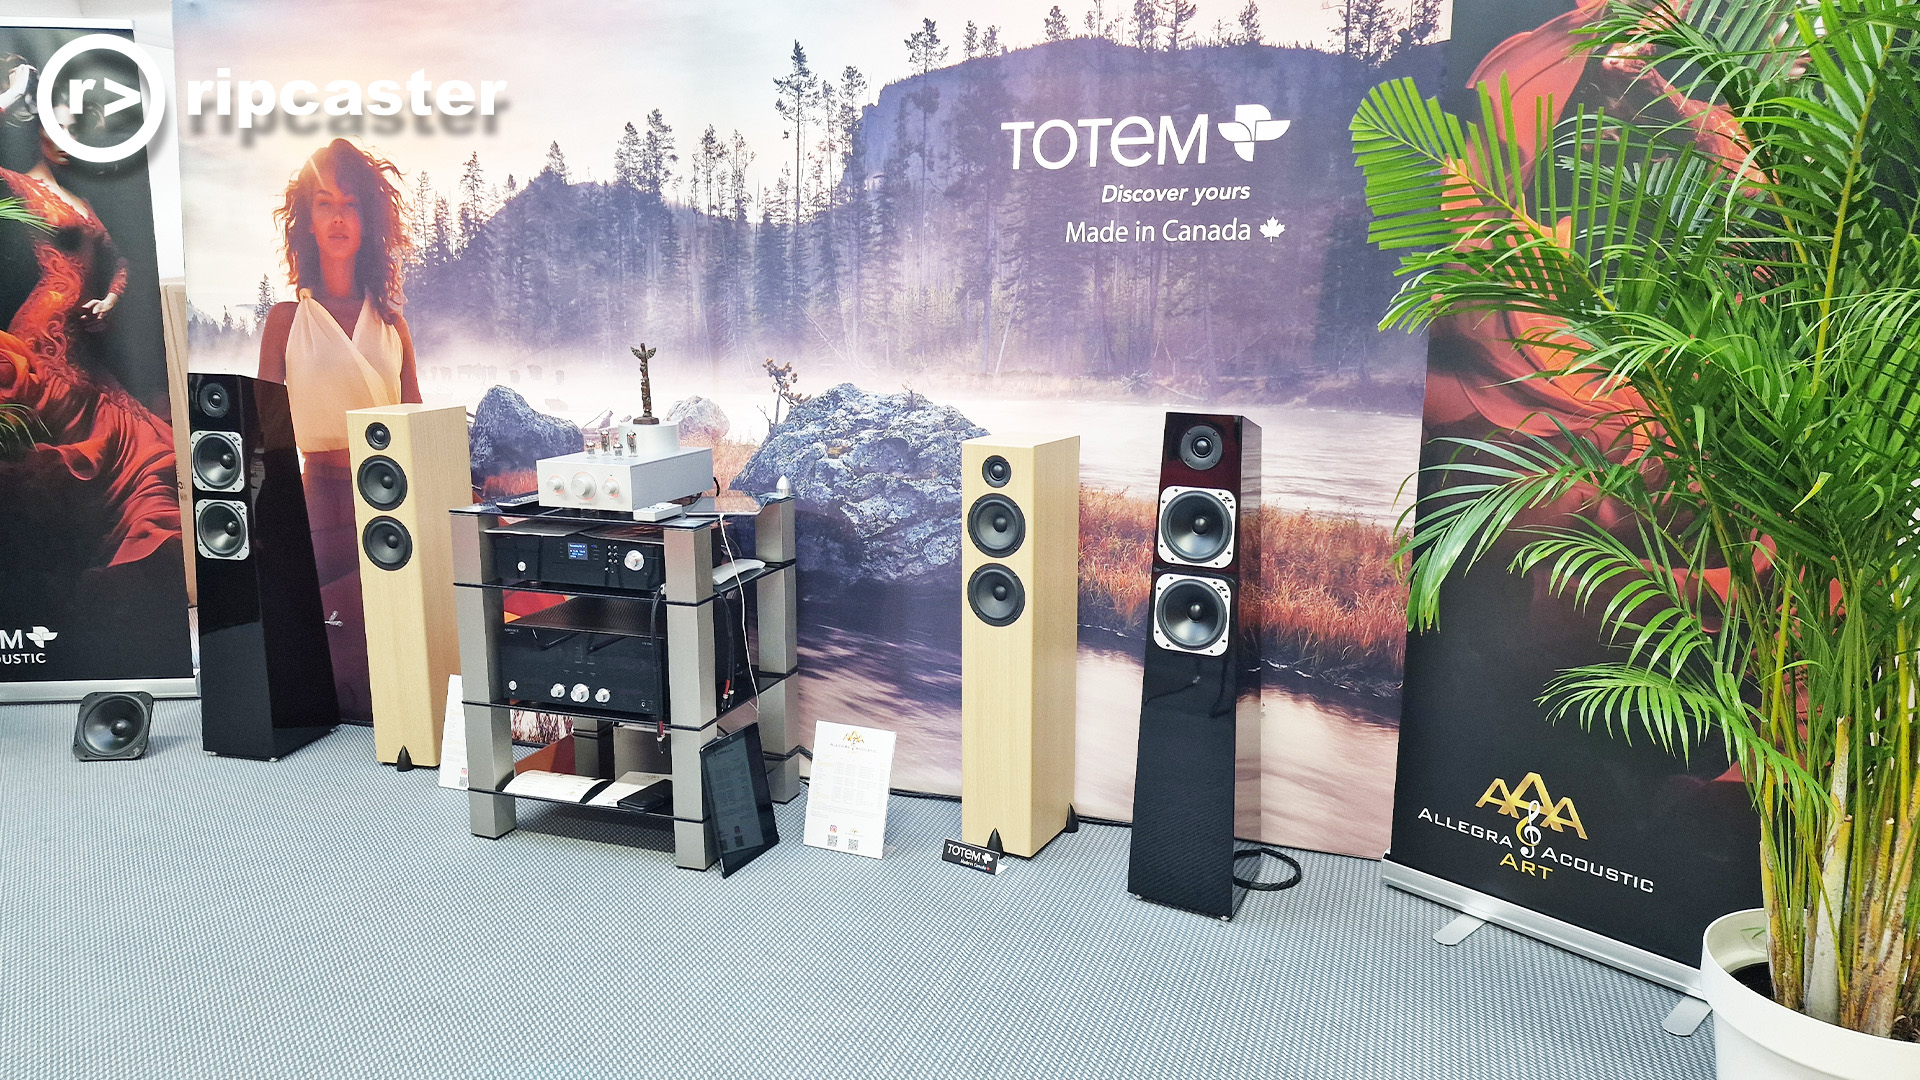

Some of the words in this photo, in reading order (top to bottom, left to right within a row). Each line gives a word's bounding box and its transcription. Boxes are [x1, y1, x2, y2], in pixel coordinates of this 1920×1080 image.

[1101, 184, 1189, 203] Discover
[1191, 185, 1251, 206] yours
[1065, 219, 1129, 243] Made
[1135, 220, 1156, 243] in
[1162, 217, 1251, 242] Canada
[1417, 807, 1514, 849] ALLEGRA
[1540, 847, 1655, 894] ACOUSTIC
[1499, 853, 1554, 881] ART
